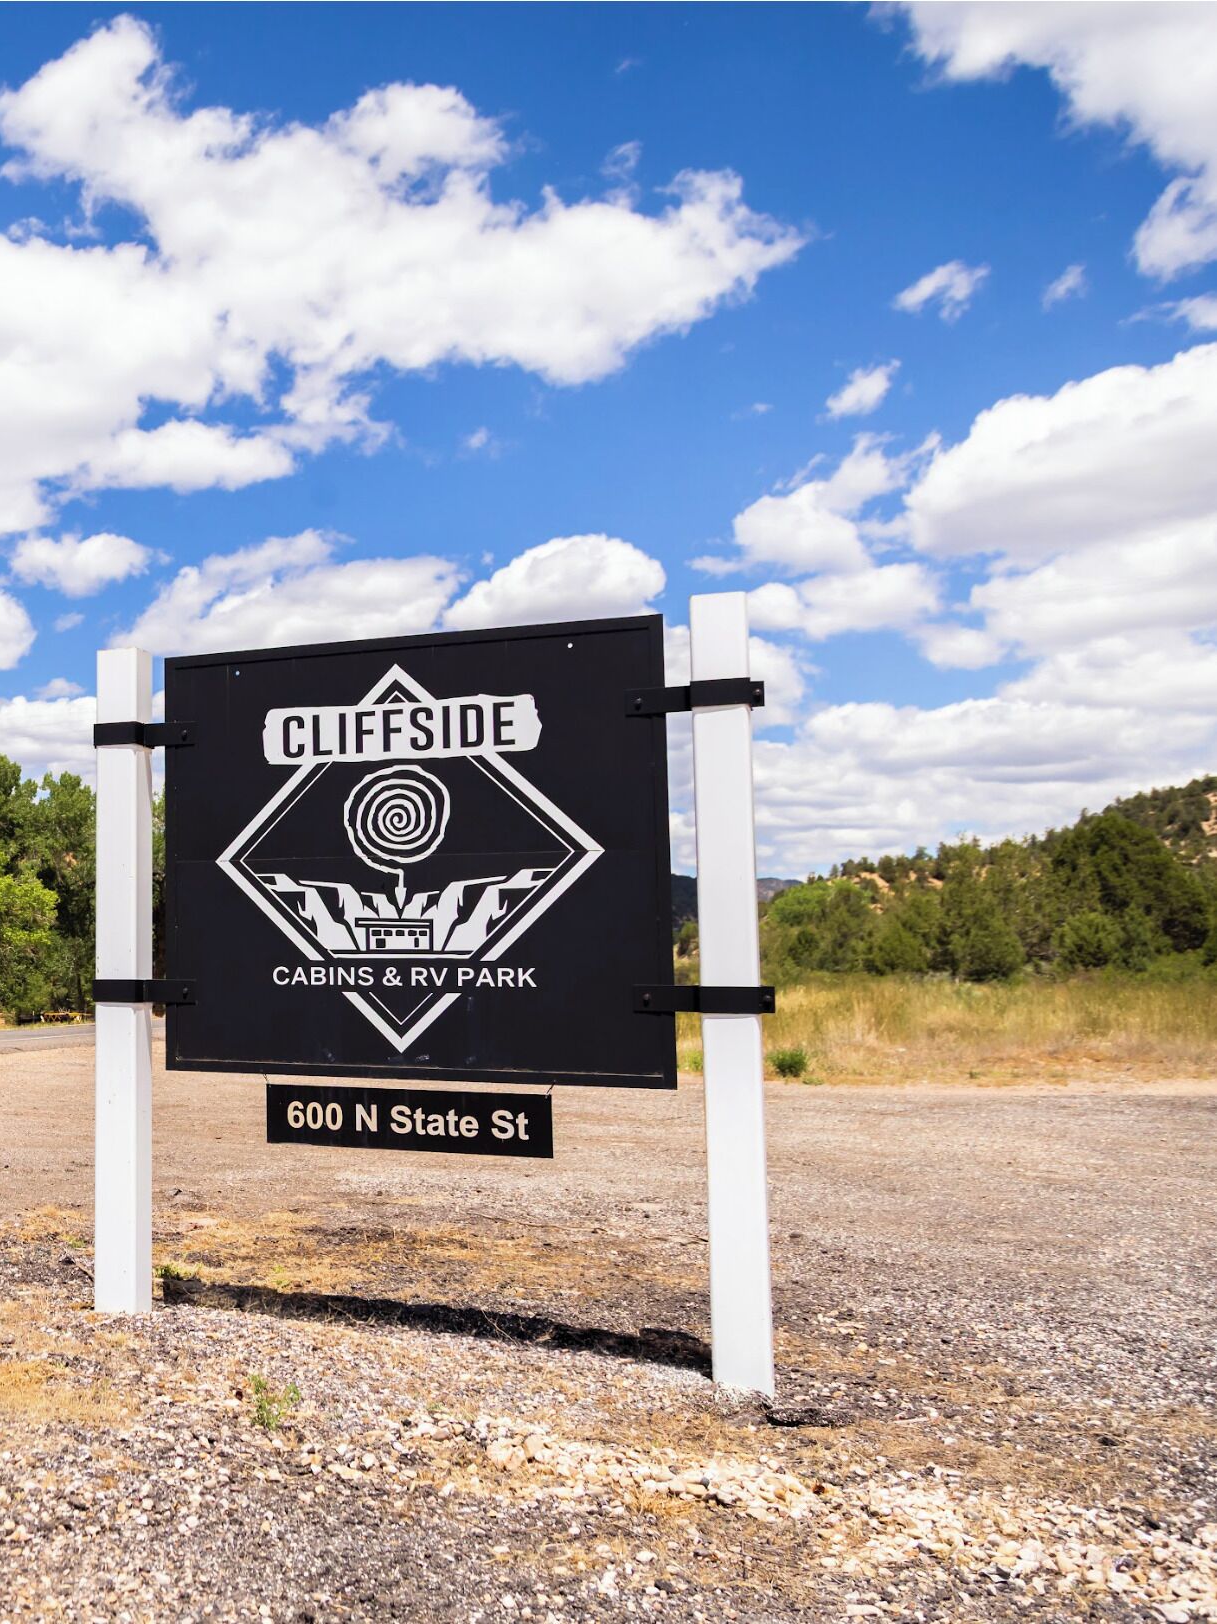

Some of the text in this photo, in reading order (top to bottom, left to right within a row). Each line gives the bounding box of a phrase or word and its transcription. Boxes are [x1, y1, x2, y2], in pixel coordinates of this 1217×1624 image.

[282, 701, 516, 759] CLIFFSIDE
[272, 966, 537, 988] CABINS & RV PARK
[286, 1100, 530, 1141] 600 N State St
